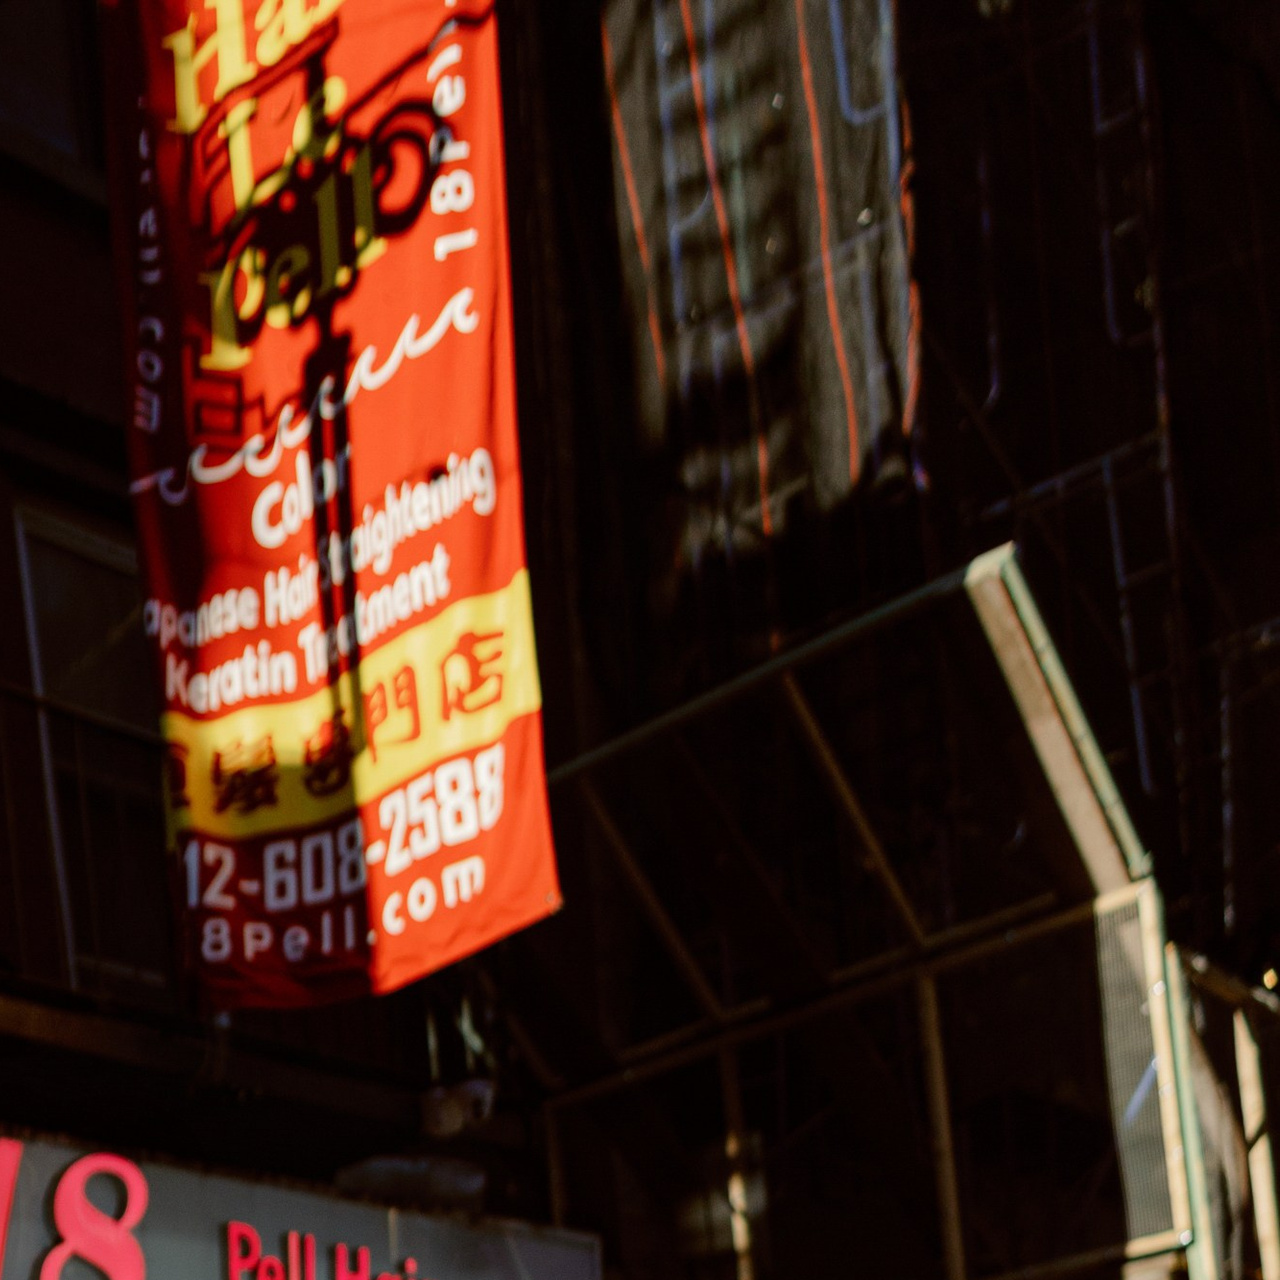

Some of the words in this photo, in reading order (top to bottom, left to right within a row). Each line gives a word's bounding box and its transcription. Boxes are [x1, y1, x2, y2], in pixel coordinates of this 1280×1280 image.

[162, 0, 346, 135] Ha
[198, 144, 388, 372] Pell
[250, 443, 352, 550] Color
[143, 585, 261, 651] apanese
[263, 553, 320, 629] Hair
[165, 638, 298, 715] Keratin
[298, 542, 451, 686] Treatment
[184, 741, 506, 911] 12-608-2588
